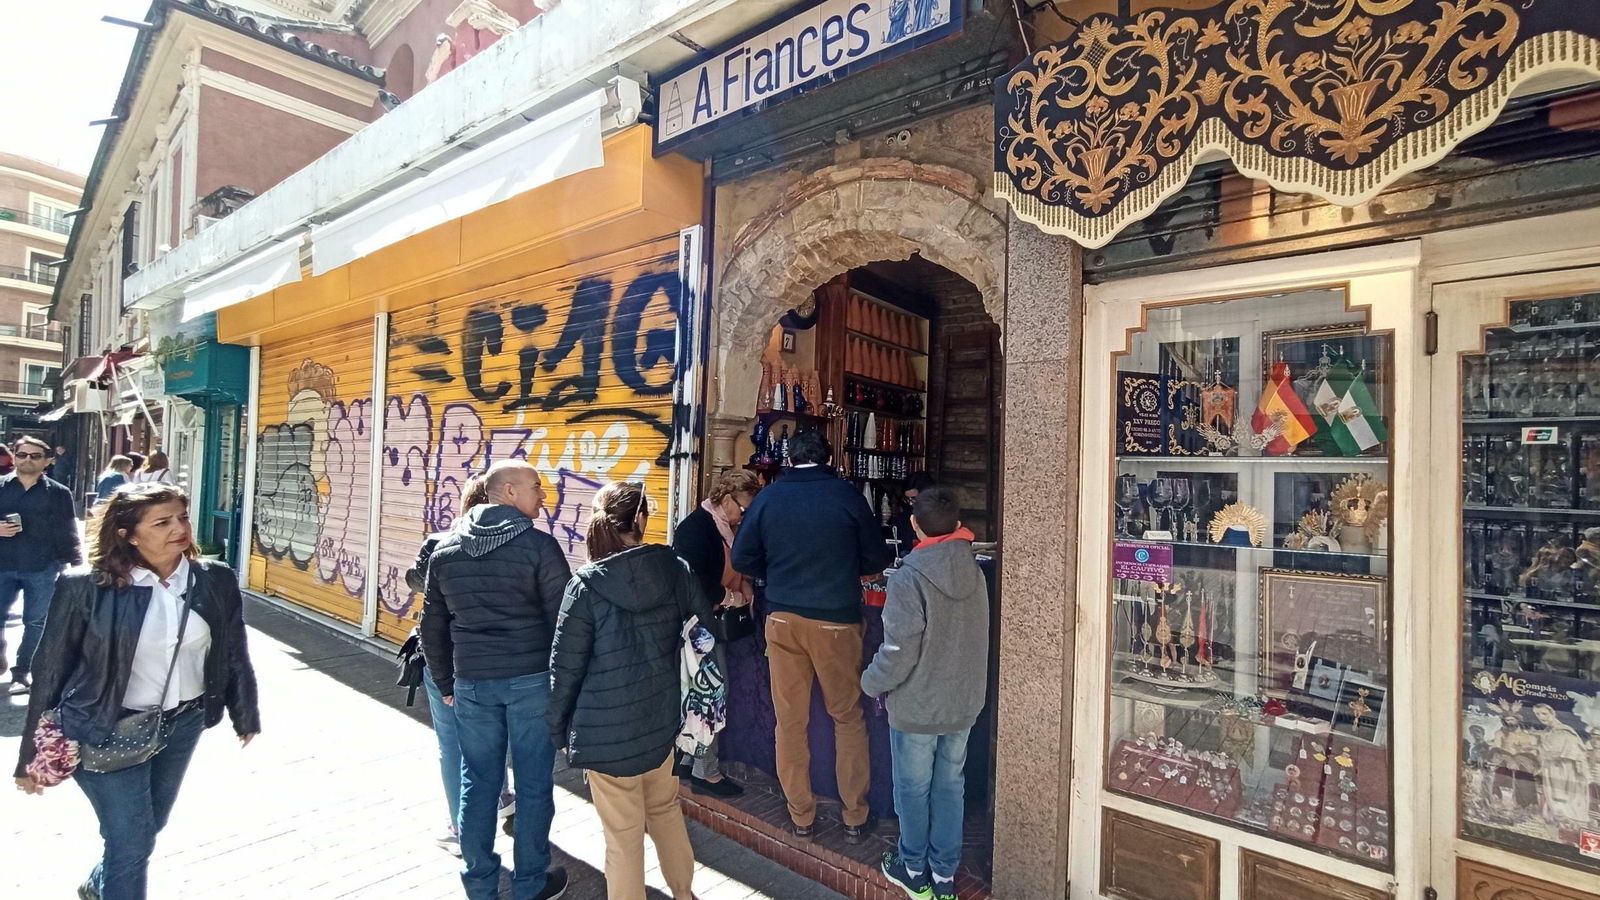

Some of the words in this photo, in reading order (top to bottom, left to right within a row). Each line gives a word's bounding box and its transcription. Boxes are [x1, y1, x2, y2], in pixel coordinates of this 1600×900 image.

[1496, 672, 1513, 689] Al
[1512, 678, 1557, 693] Compás
[1512, 684, 1547, 697] Cofrade
[1547, 692, 1569, 701] 2020
